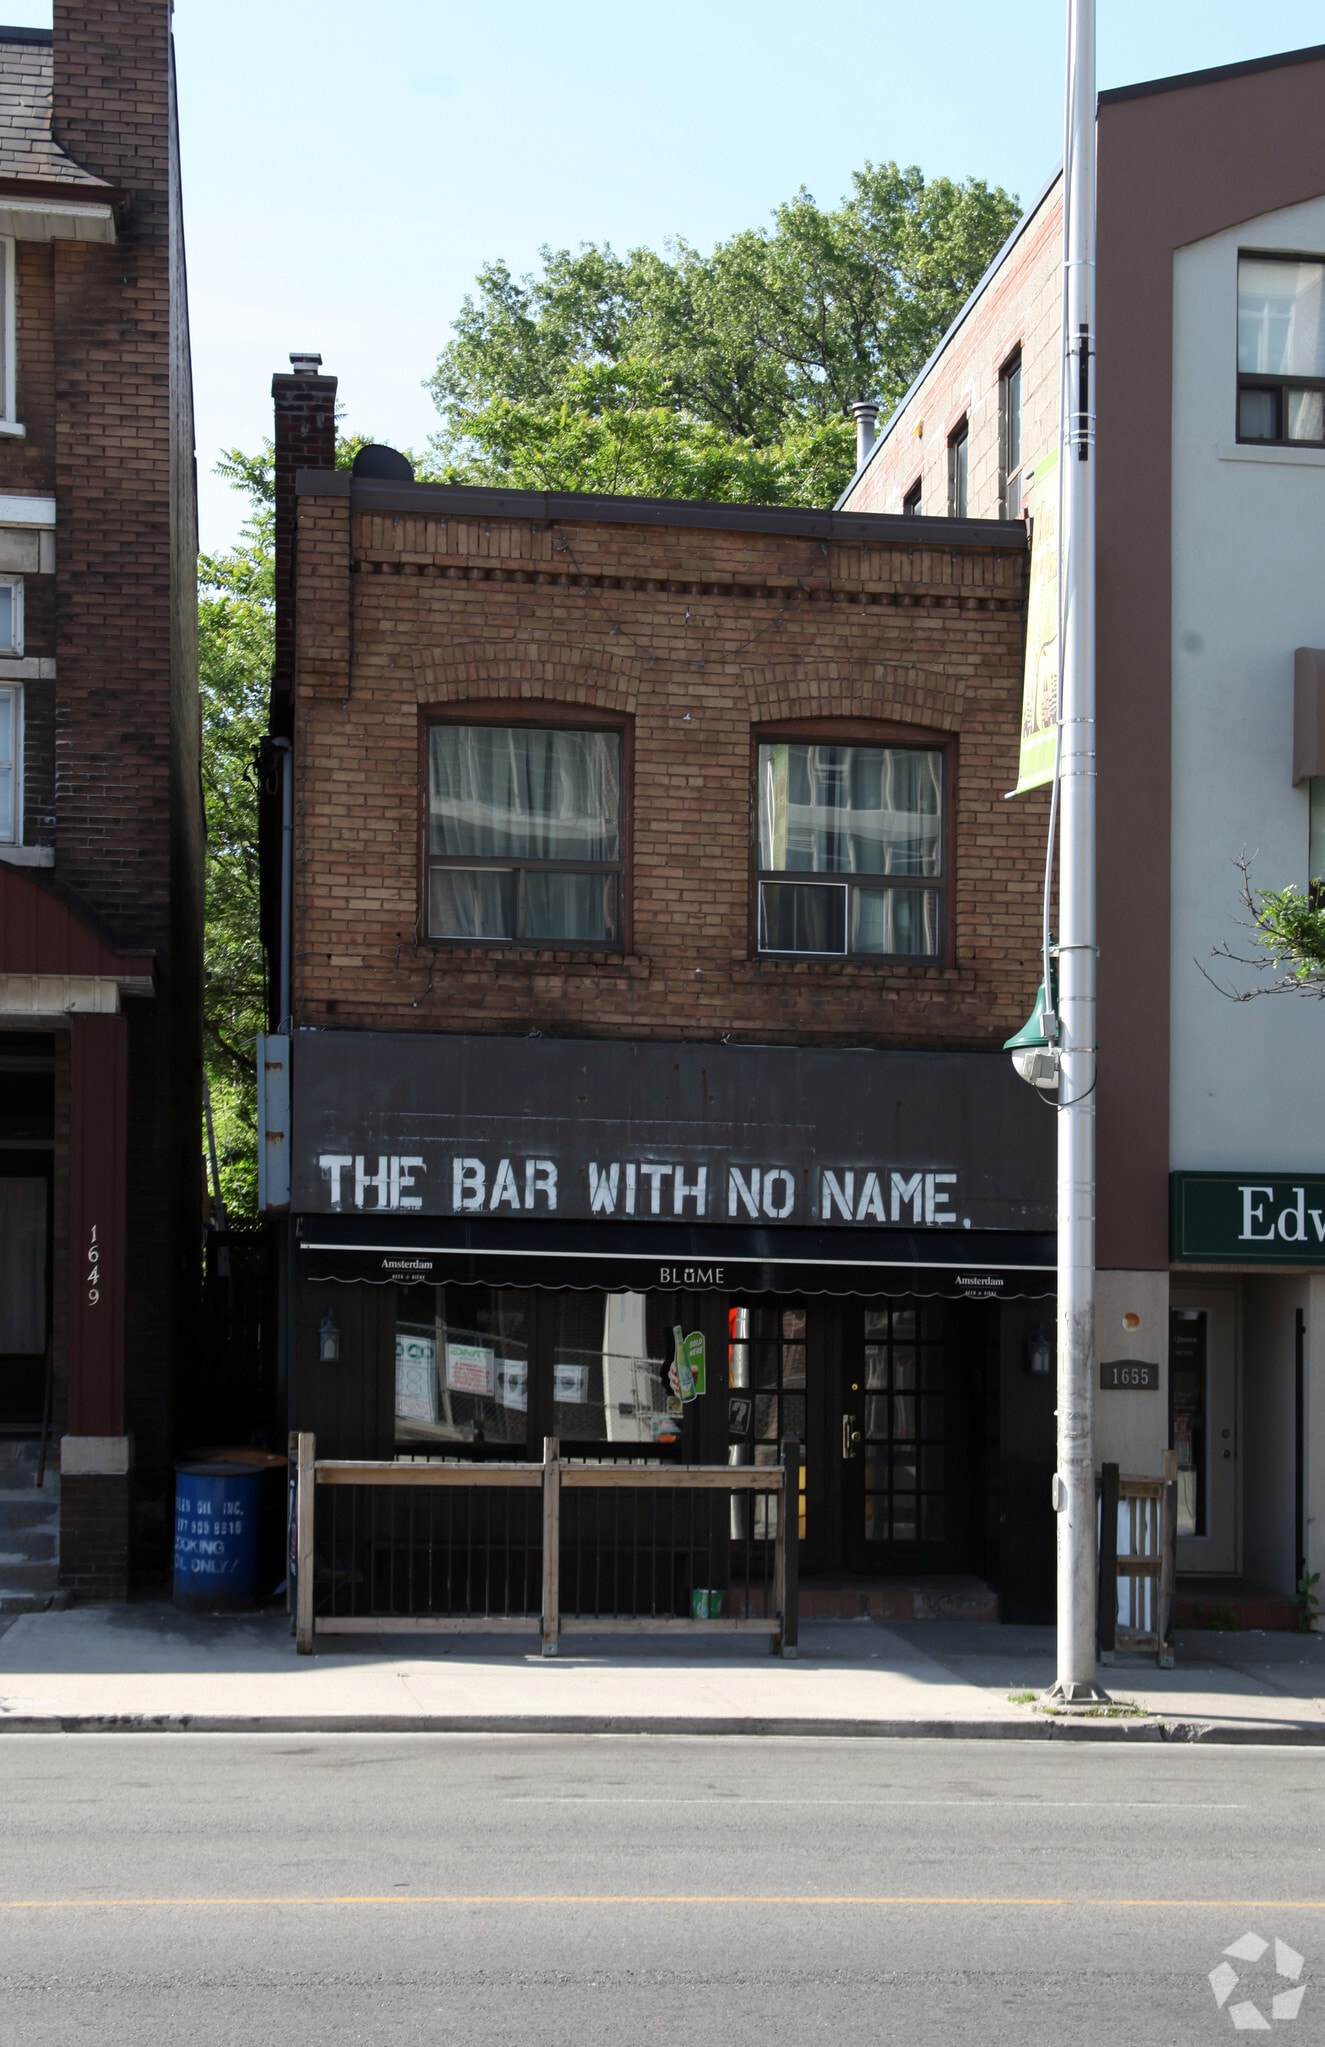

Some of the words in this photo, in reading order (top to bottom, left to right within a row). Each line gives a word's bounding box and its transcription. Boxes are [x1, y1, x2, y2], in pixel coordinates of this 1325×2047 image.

[319, 1154, 427, 1211] THE
[452, 1157, 558, 1212] BAR
[588, 1161, 708, 1215] WITH
[728, 1167, 795, 1219] NO
[821, 1170, 972, 1229] NAME.
[87, 1224, 100, 1307] 1649
[381, 1258, 433, 1270] Amsterdam
[954, 1275, 1004, 1286] Amsterdam
[689, 1337, 703, 1348] SOLD
[1112, 1367, 1149, 1385] 1655
[197, 1500, 212, 1515] OIL
